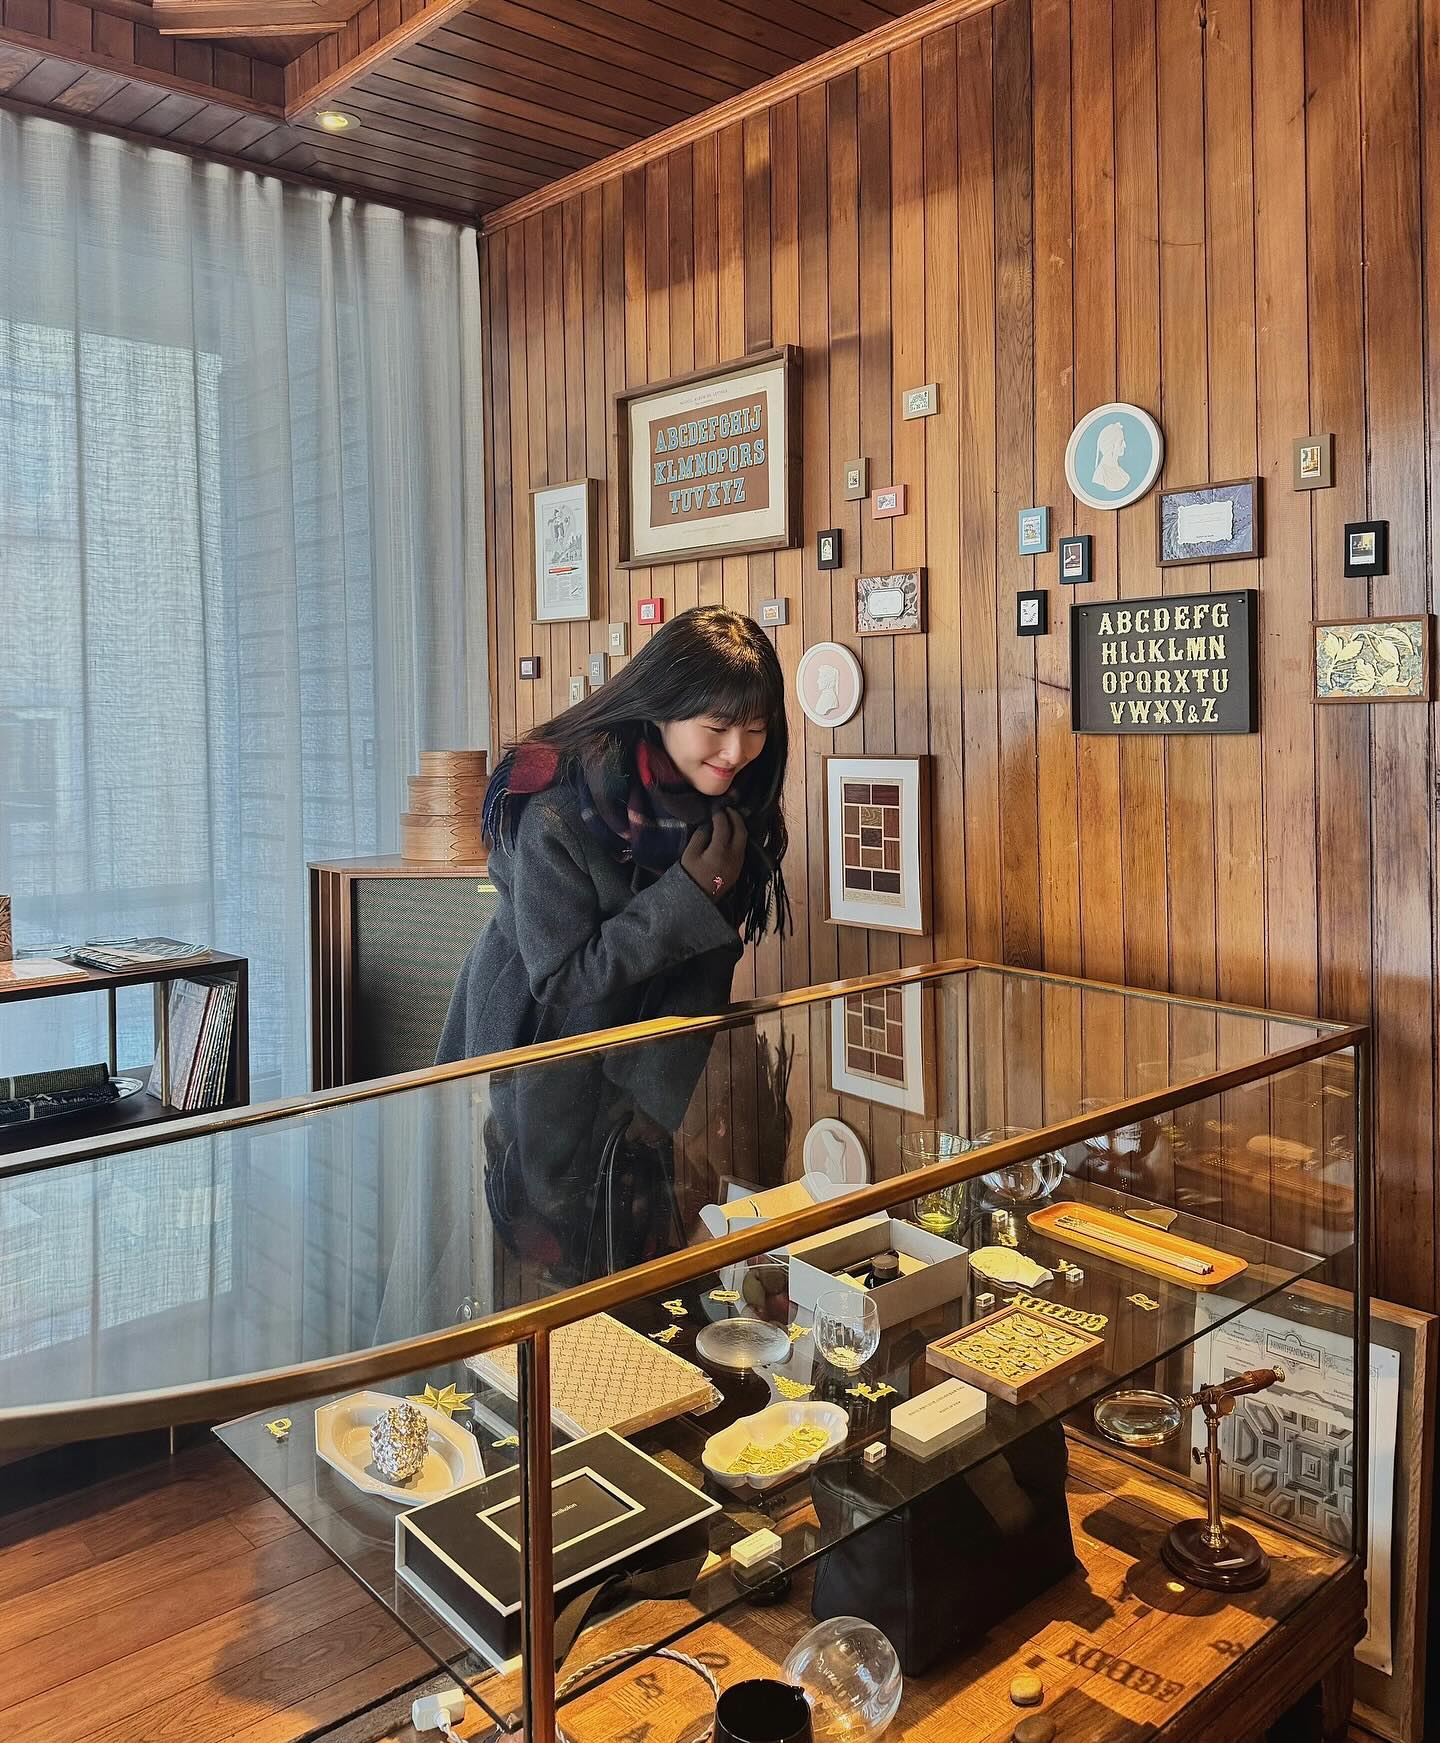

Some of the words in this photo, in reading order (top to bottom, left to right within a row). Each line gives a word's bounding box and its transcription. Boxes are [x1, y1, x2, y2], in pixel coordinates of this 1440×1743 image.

[655, 404, 762, 454] ABCDEFGHIJ
[653, 439, 766, 486] KLMNOPQRS
[669, 477, 746, 514] TUVXYZ
[1098, 602, 1229, 635] ABCDEFG
[1101, 634, 1226, 665] HIJKLMN
